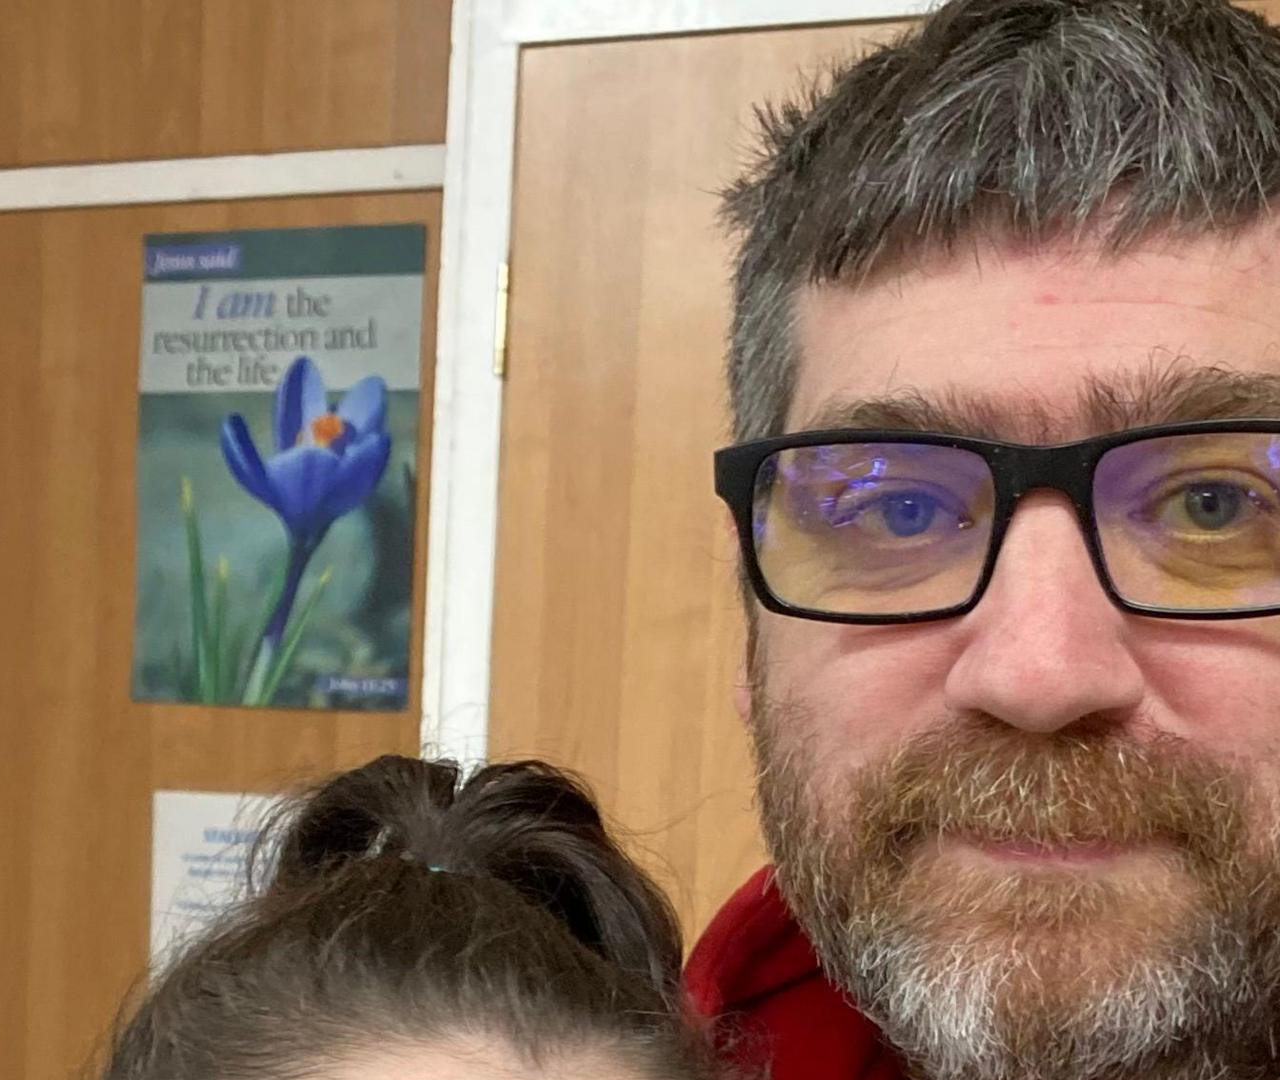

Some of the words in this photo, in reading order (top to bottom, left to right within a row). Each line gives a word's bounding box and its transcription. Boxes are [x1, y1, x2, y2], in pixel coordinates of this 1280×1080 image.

[193, 285, 210, 320] I
[217, 292, 276, 320] am
[286, 286, 333, 318] the
[153, 324, 318, 354] resurrection
[324, 316, 377, 350] and
[186, 355, 233, 386] the
[237, 353, 280, 385] life
